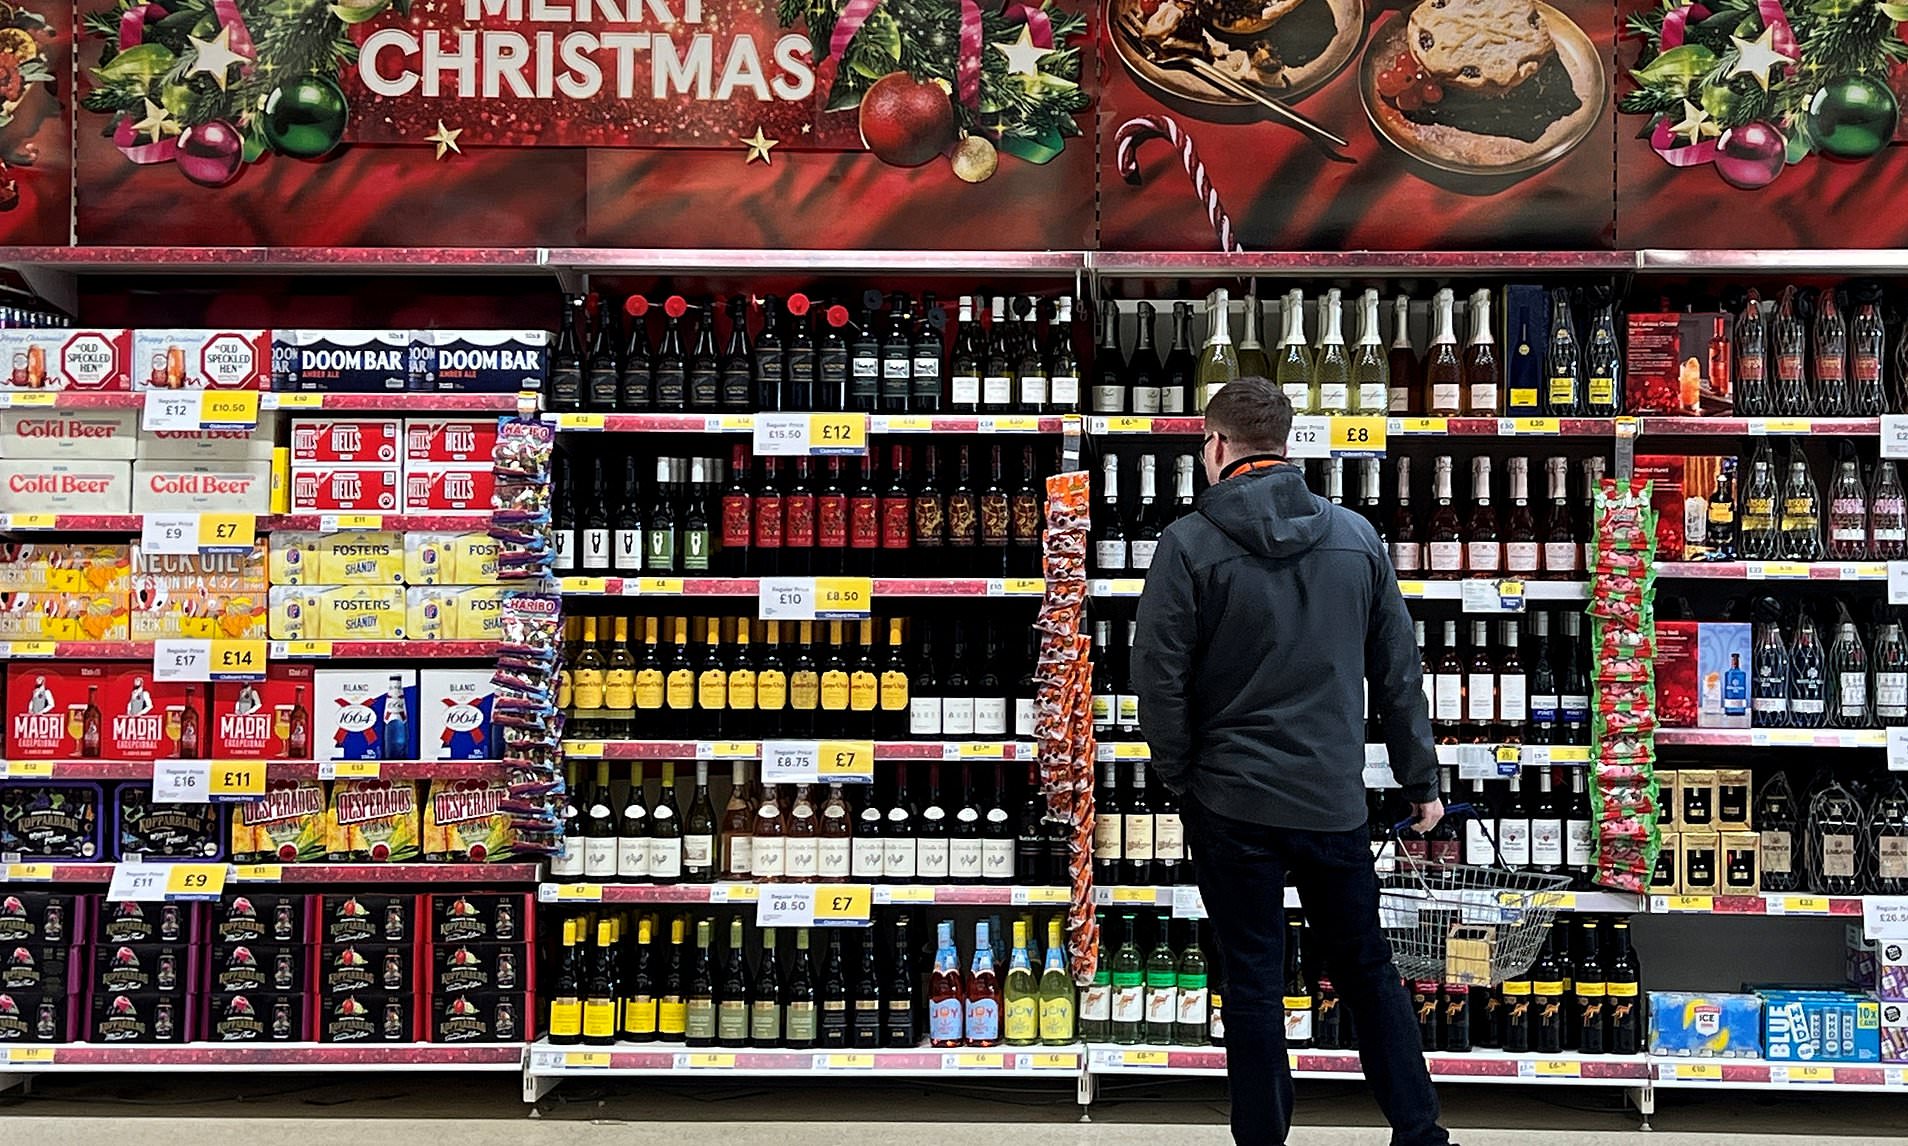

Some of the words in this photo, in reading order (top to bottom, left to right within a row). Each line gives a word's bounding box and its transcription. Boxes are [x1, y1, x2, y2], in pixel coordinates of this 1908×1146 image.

[358, 31, 815, 101] CHRISTMAS
[67, 353, 110, 363] SPECKLED
[206, 353, 250, 363] SPECKLED
[302, 350, 361, 371] DOOM
[364, 350, 403, 371] BAR
[439, 350, 498, 371] DOOM
[501, 350, 540, 371] BAR
[166, 405, 187, 416] £12
[212, 403, 246, 413] £10.50
[16, 420, 64, 439] Cold
[68, 420, 116, 439] Beer
[768, 430, 802, 439] £15.50
[823, 425, 852, 440] £12
[1347, 428, 1369, 443] £8
[332, 431, 362, 452] HELLS
[445, 431, 475, 452] HELLS
[1295, 432, 1316, 443] £12
[1897, 432, 1908, 441] £2
[9, 474, 58, 494] Cold
[61, 474, 110, 494] Beer
[150, 474, 198, 494] Cold
[202, 474, 251, 494] Beer
[332, 480, 362, 500] HELLS
[445, 480, 475, 500] HELLS
[165, 528, 182, 539] £9
[216, 523, 238, 539] £7
[333, 545, 390, 556] FOSTER'S
[469, 545, 498, 556] FOST
[130, 543, 195, 573] NECK
[345, 561, 377, 575] SHANDY
[481, 563, 498, 575] SHA
[779, 594, 802, 605] £10
[826, 592, 859, 602] £8.50
[334, 600, 391, 611] FOSTER'S
[471, 600, 502, 611] FOST
[510, 599, 556, 612] HARIBO
[346, 615, 378, 630] SHANDY
[483, 617, 503, 630] SHA
[175, 655, 196, 667] £17
[222, 651, 253, 667] £14
[343, 683, 369, 692] BLANC
[450, 683, 476, 692] BLANC
[338, 711, 372, 724] 1664
[445, 711, 480, 724] 1664
[777, 757, 810, 767] £8.75
[835, 753, 856, 768] £7
[174, 776, 196, 787] £16
[223, 772, 251, 787] £11
[244, 789, 320, 825] DESPERADOS
[339, 791, 412, 824] DESPERADOS
[436, 790, 505, 822] DESPERADO
[132, 878, 153, 888] £11
[184, 875, 208, 888] £9
[773, 901, 806, 911] £8.50
[832, 897, 853, 911] £7
[1699, 1014, 1715, 1023] ICE
[1769, 1006, 1791, 1058] BLUE
